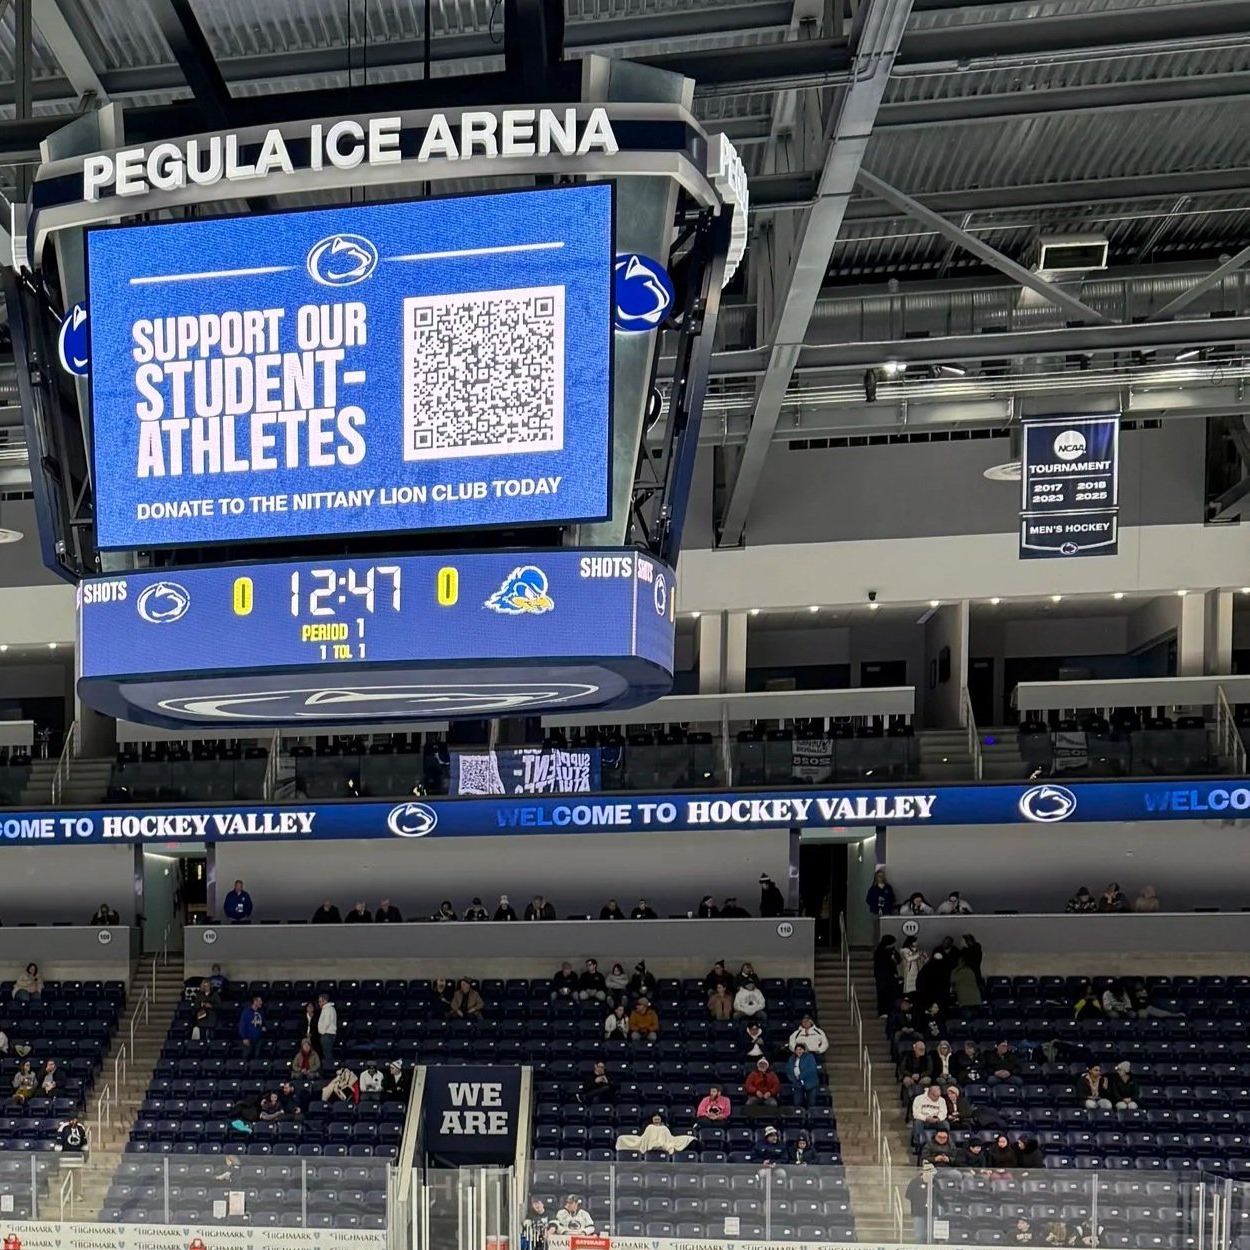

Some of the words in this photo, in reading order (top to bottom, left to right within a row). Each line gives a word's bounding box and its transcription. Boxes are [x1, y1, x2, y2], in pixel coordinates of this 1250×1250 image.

[83, 129, 294, 203] PEGULA
[311, 117, 402, 171] ICE
[418, 108, 619, 162] ARENA
[132, 308, 285, 363] SUPPORT
[297, 301, 367, 351] OUR
[134, 348, 367, 422] STUDENT-
[136, 405, 367, 478] ATHLETES
[1058, 444, 1084, 453] NCAA
[1029, 461, 1111, 473] TOURNAMENT
[137, 500, 213, 520] DONATE
[218, 498, 245, 514] TO
[249, 495, 288, 513] THE
[292, 488, 376, 511] NITTANY
[380, 485, 427, 505] LION
[432, 481, 488, 501] CLUB
[491, 477, 562, 498] TODAY
[1033, 494, 1064, 503] 2023
[1075, 492, 1107, 501] 2025
[1034, 484, 1063, 492] 2017
[1077, 481, 1106, 490] 2018
[1030, 525, 1063, 534] MEN'S
[1065, 523, 1110, 533] HOCKEY
[580, 557, 633, 578] SHOTS
[83, 581, 128, 603] SHOTS
[233, 576, 254, 616] 0
[290, 566, 401, 617] 12:47
[437, 566, 459, 606] 0
[302, 623, 349, 642] PERIOD
[356, 618, 365, 638] 1
[320, 645, 327, 660] 1
[359, 643, 366, 659] 1
[497, 805, 631, 828] WELCOME
[638, 803, 677, 824] TO
[687, 798, 812, 824] HOCKEY
[812, 795, 936, 820] VALLEY
[60, 817, 94, 838] TO
[102, 814, 207, 837] HOCKEY
[212, 812, 316, 835] VALLEY
[448, 1082, 502, 1106] WE
[440, 1111, 508, 1134] ARE
